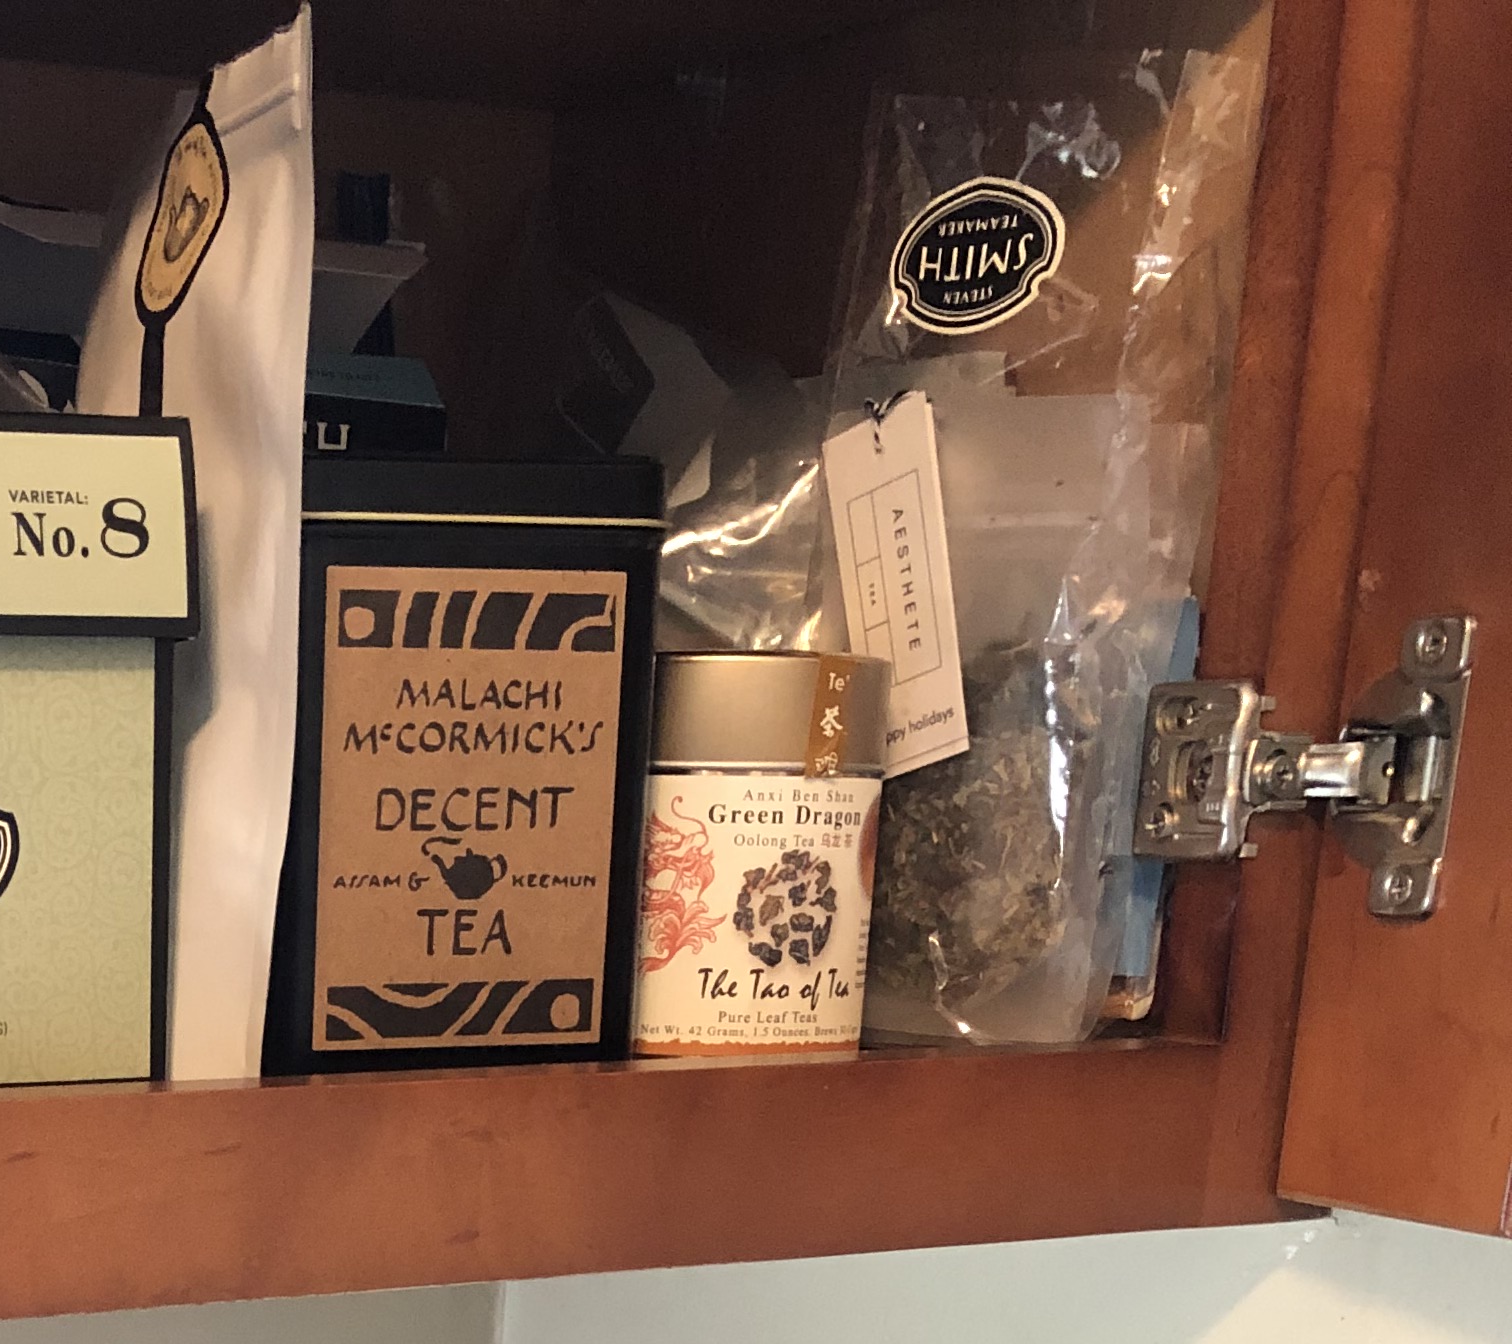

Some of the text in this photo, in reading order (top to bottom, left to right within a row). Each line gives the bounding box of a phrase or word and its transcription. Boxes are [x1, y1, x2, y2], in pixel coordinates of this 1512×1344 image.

[938, 211, 1019, 238] TEAMAKER
[918, 232, 1034, 284] SMITH
[943, 285, 994, 305] STEVEN
[8, 488, 89, 506] VARIETAL:
[13, 497, 151, 560] No. 8
[891, 507, 922, 652] AESTHETE
[396, 678, 563, 711] MALACHI
[907, 706, 955, 735] holidays
[375, 786, 576, 833] DECENT
[743, 788, 784, 803] Anxi
[791, 788, 819, 803] Ben
[707, 803, 862, 831] Green Dragon
[733, 833, 787, 850] Oolong
[793, 834, 815, 848] Tea
[333, 872, 597, 892] ASSAM & KEEMUN
[416, 908, 513, 956] TEA
[697, 967, 850, 1011] The Tao of Tea
[640, 1023, 660, 1037] Net
[688, 1025, 703, 1038] 42
[753, 1025, 768, 1038] 1.5
[717, 1010, 818, 1025] Pure Leaf Teas
